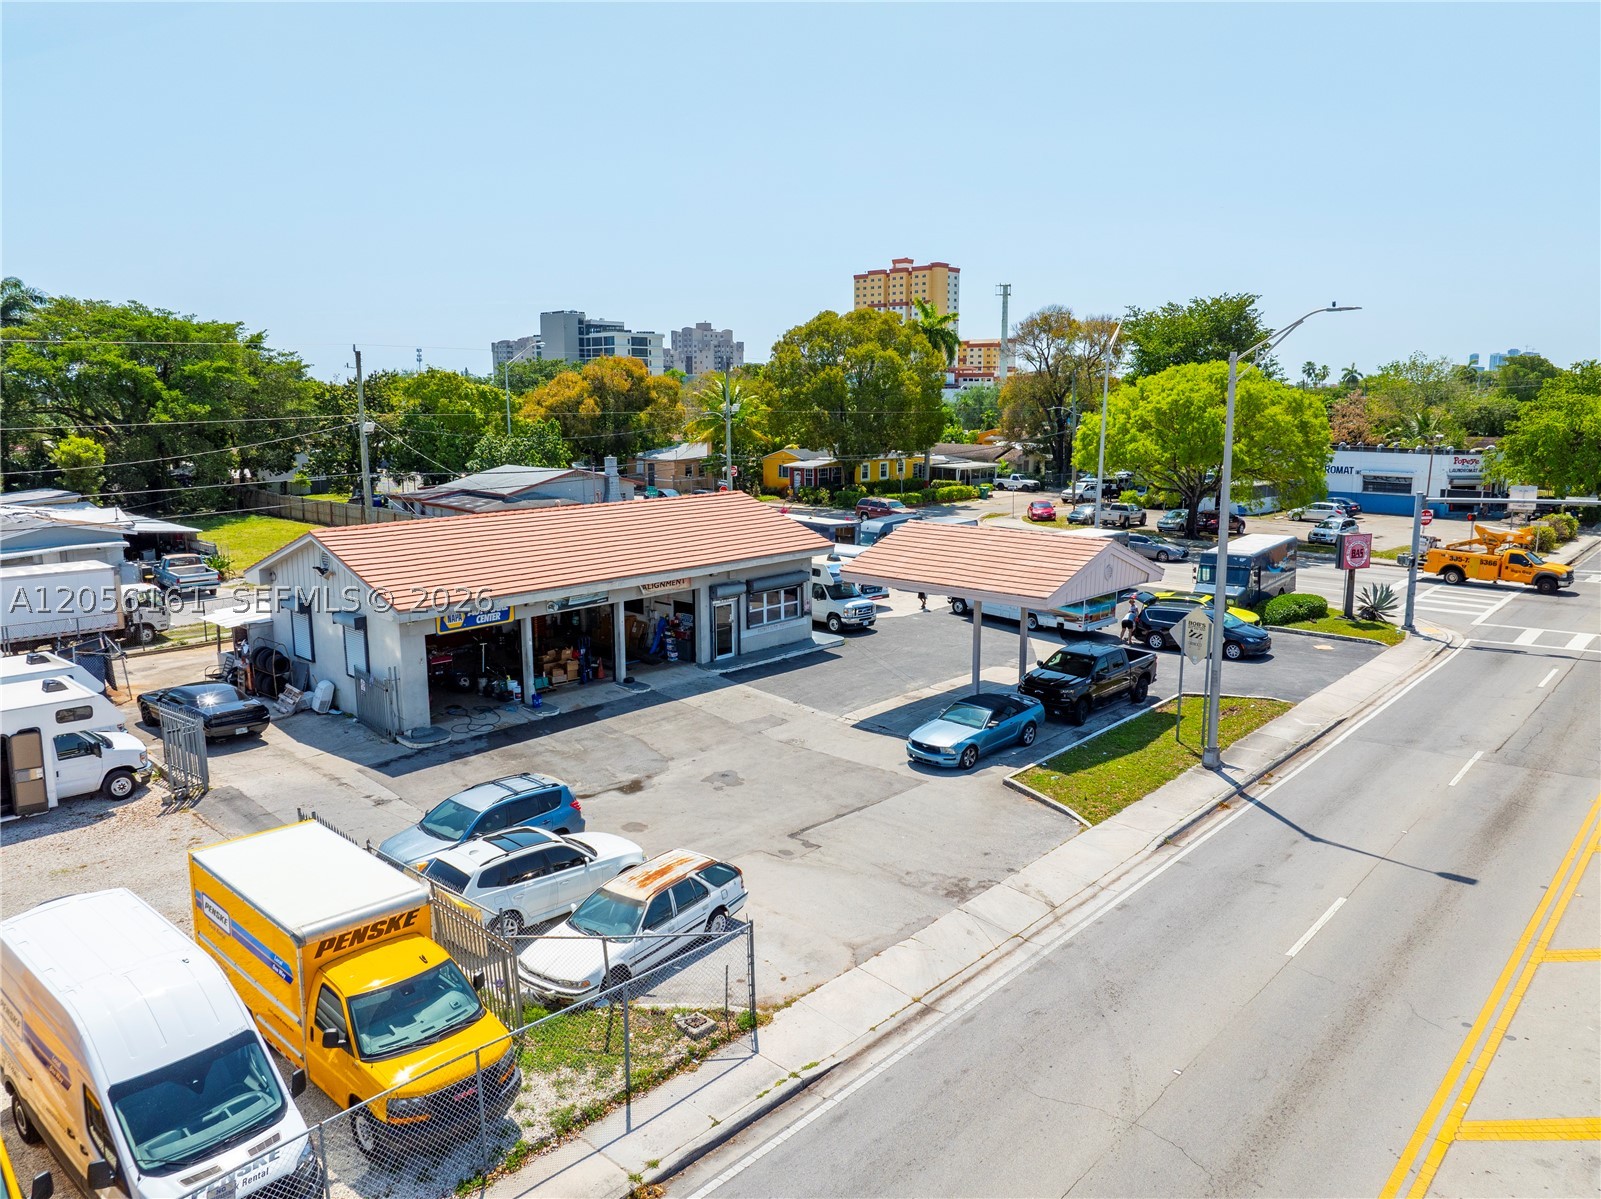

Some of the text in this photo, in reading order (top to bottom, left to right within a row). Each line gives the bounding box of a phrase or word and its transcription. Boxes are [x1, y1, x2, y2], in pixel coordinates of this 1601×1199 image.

[1453, 456, 1480, 466] Popeye
[642, 578, 686, 590] ALIGNMENT
[446, 613, 462, 624] NAPA
[476, 612, 501, 624] CENTER
[204, 901, 228, 927] PENSKE
[314, 908, 421, 960] PENSKE
[242, 1167, 269, 1187] Rental
